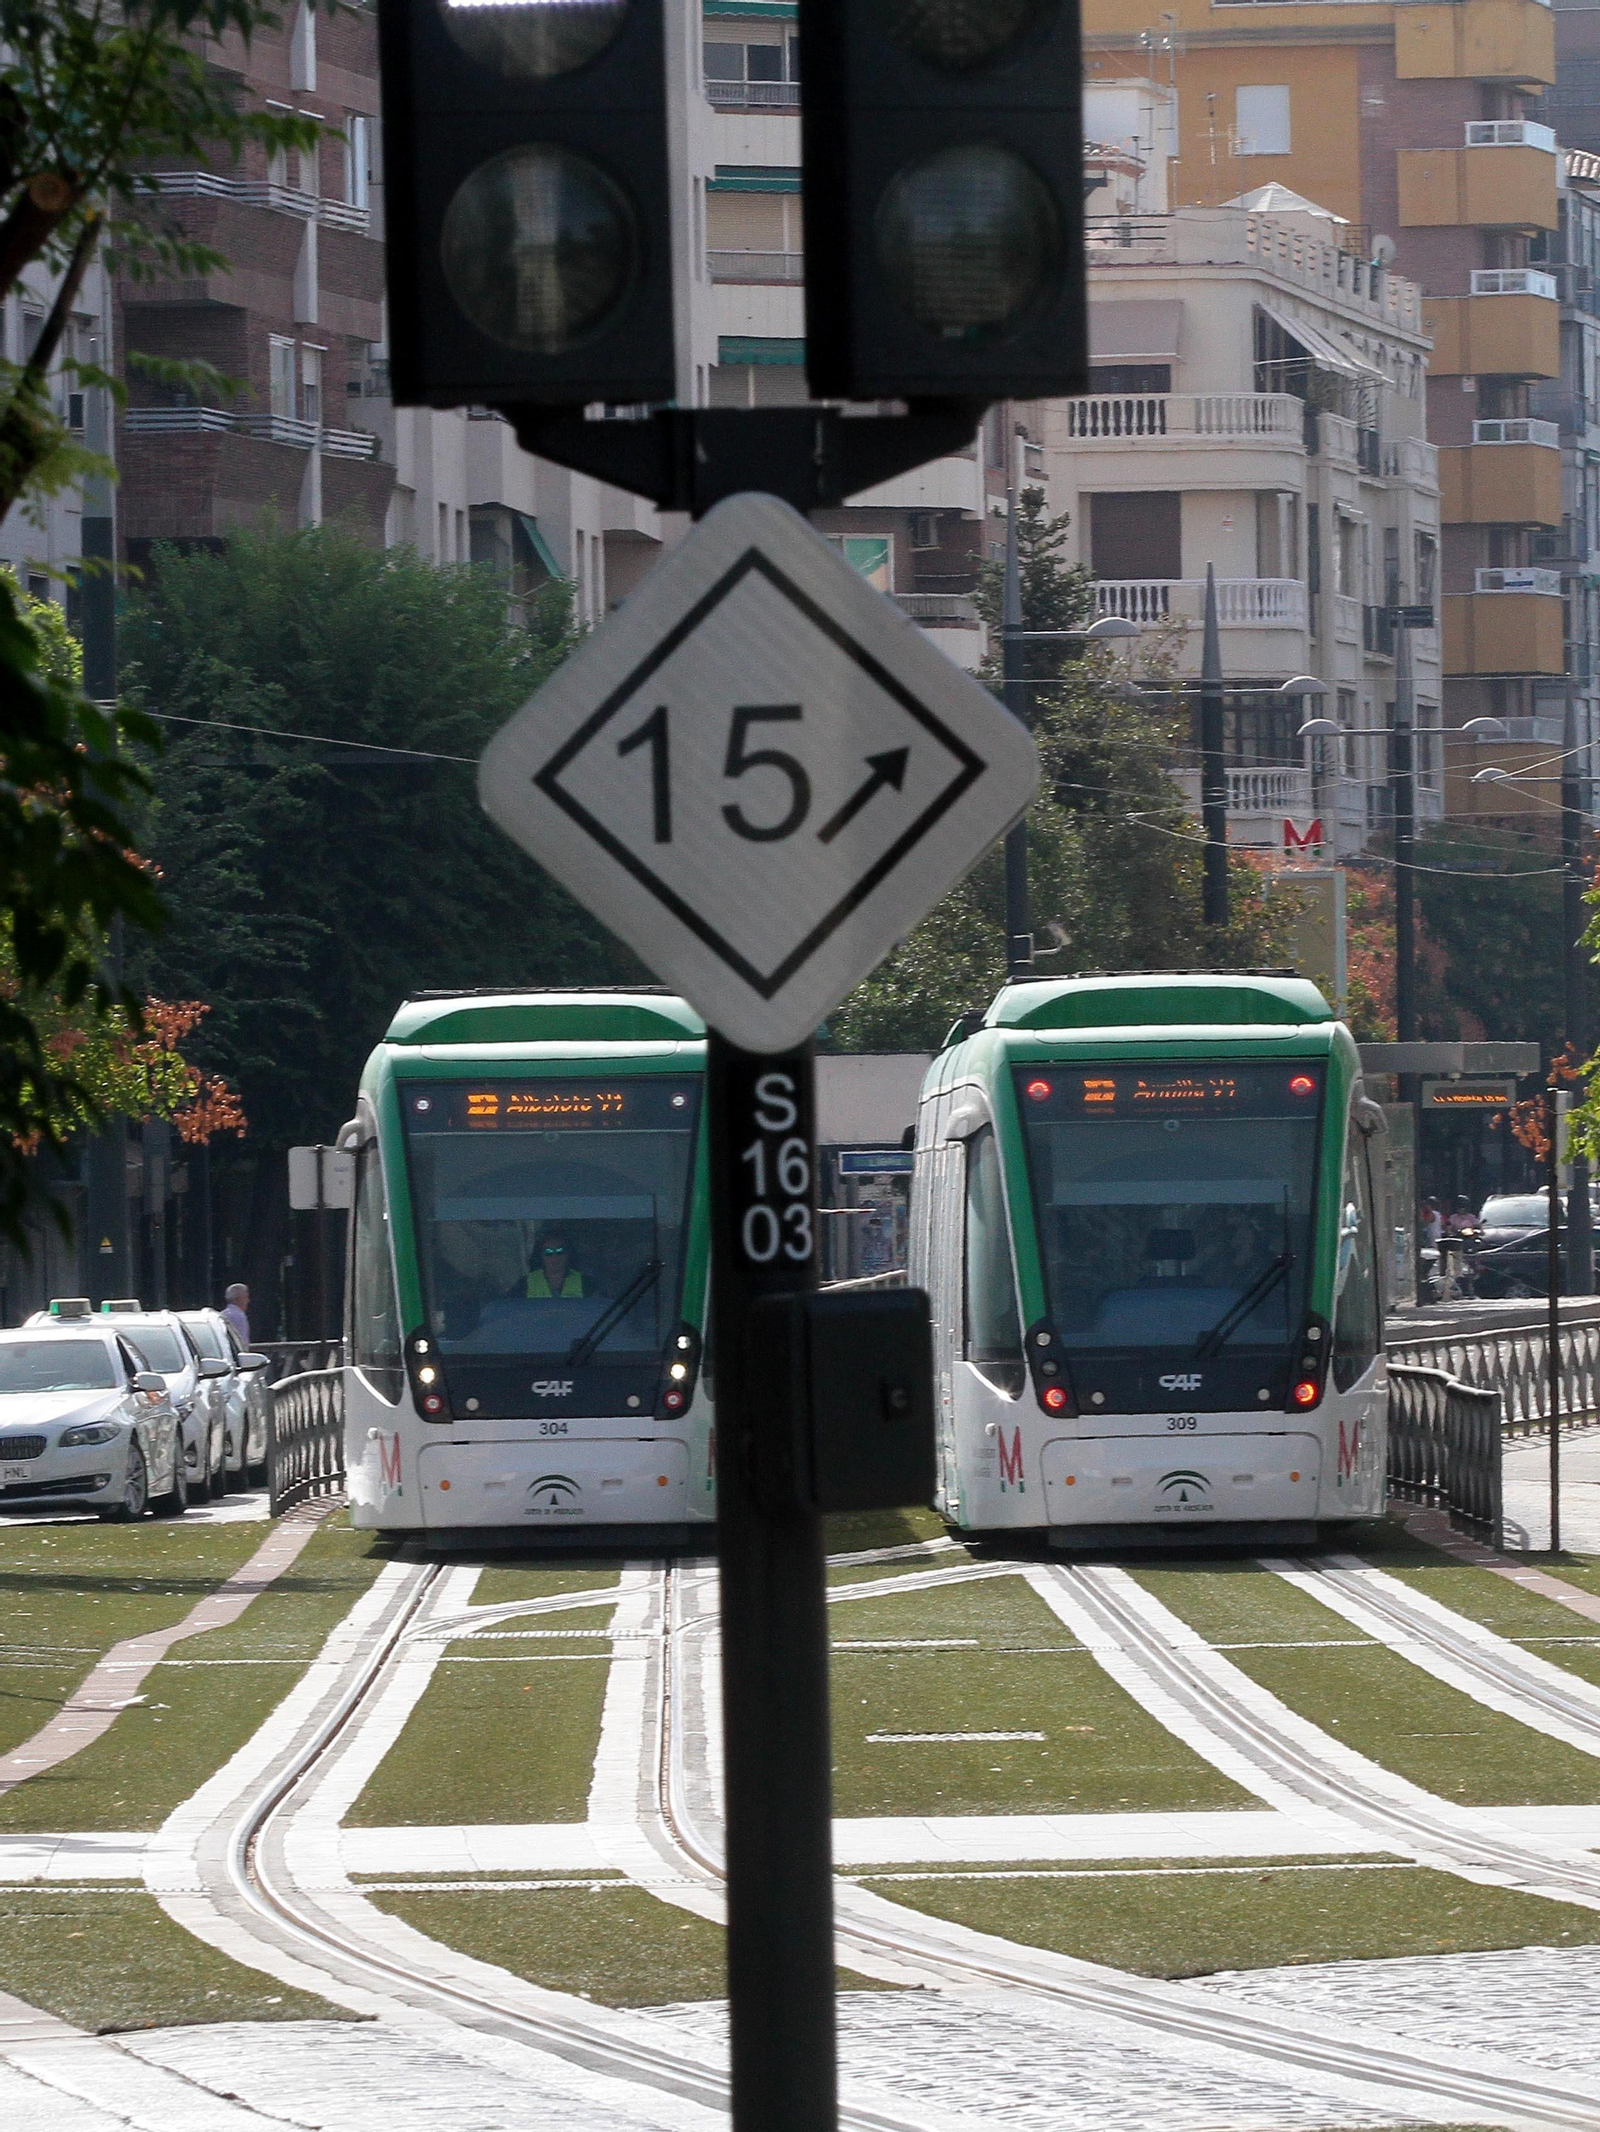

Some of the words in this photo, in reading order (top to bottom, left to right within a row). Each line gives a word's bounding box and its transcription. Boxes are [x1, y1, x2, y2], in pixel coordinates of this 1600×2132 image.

[617, 703, 812, 844] 15
[1283, 818, 1324, 856] M
[754, 1073, 798, 1132] S
[741, 1137, 810, 1197] 16
[742, 1202, 813, 1262] 03
[531, 1380, 574, 1397] CAF
[1158, 1374, 1203, 1391] CAF
[539, 1422, 568, 1435] 304
[1167, 1417, 1197, 1430] 309
[379, 1431, 403, 1496] M
[997, 1426, 1025, 1493] M
